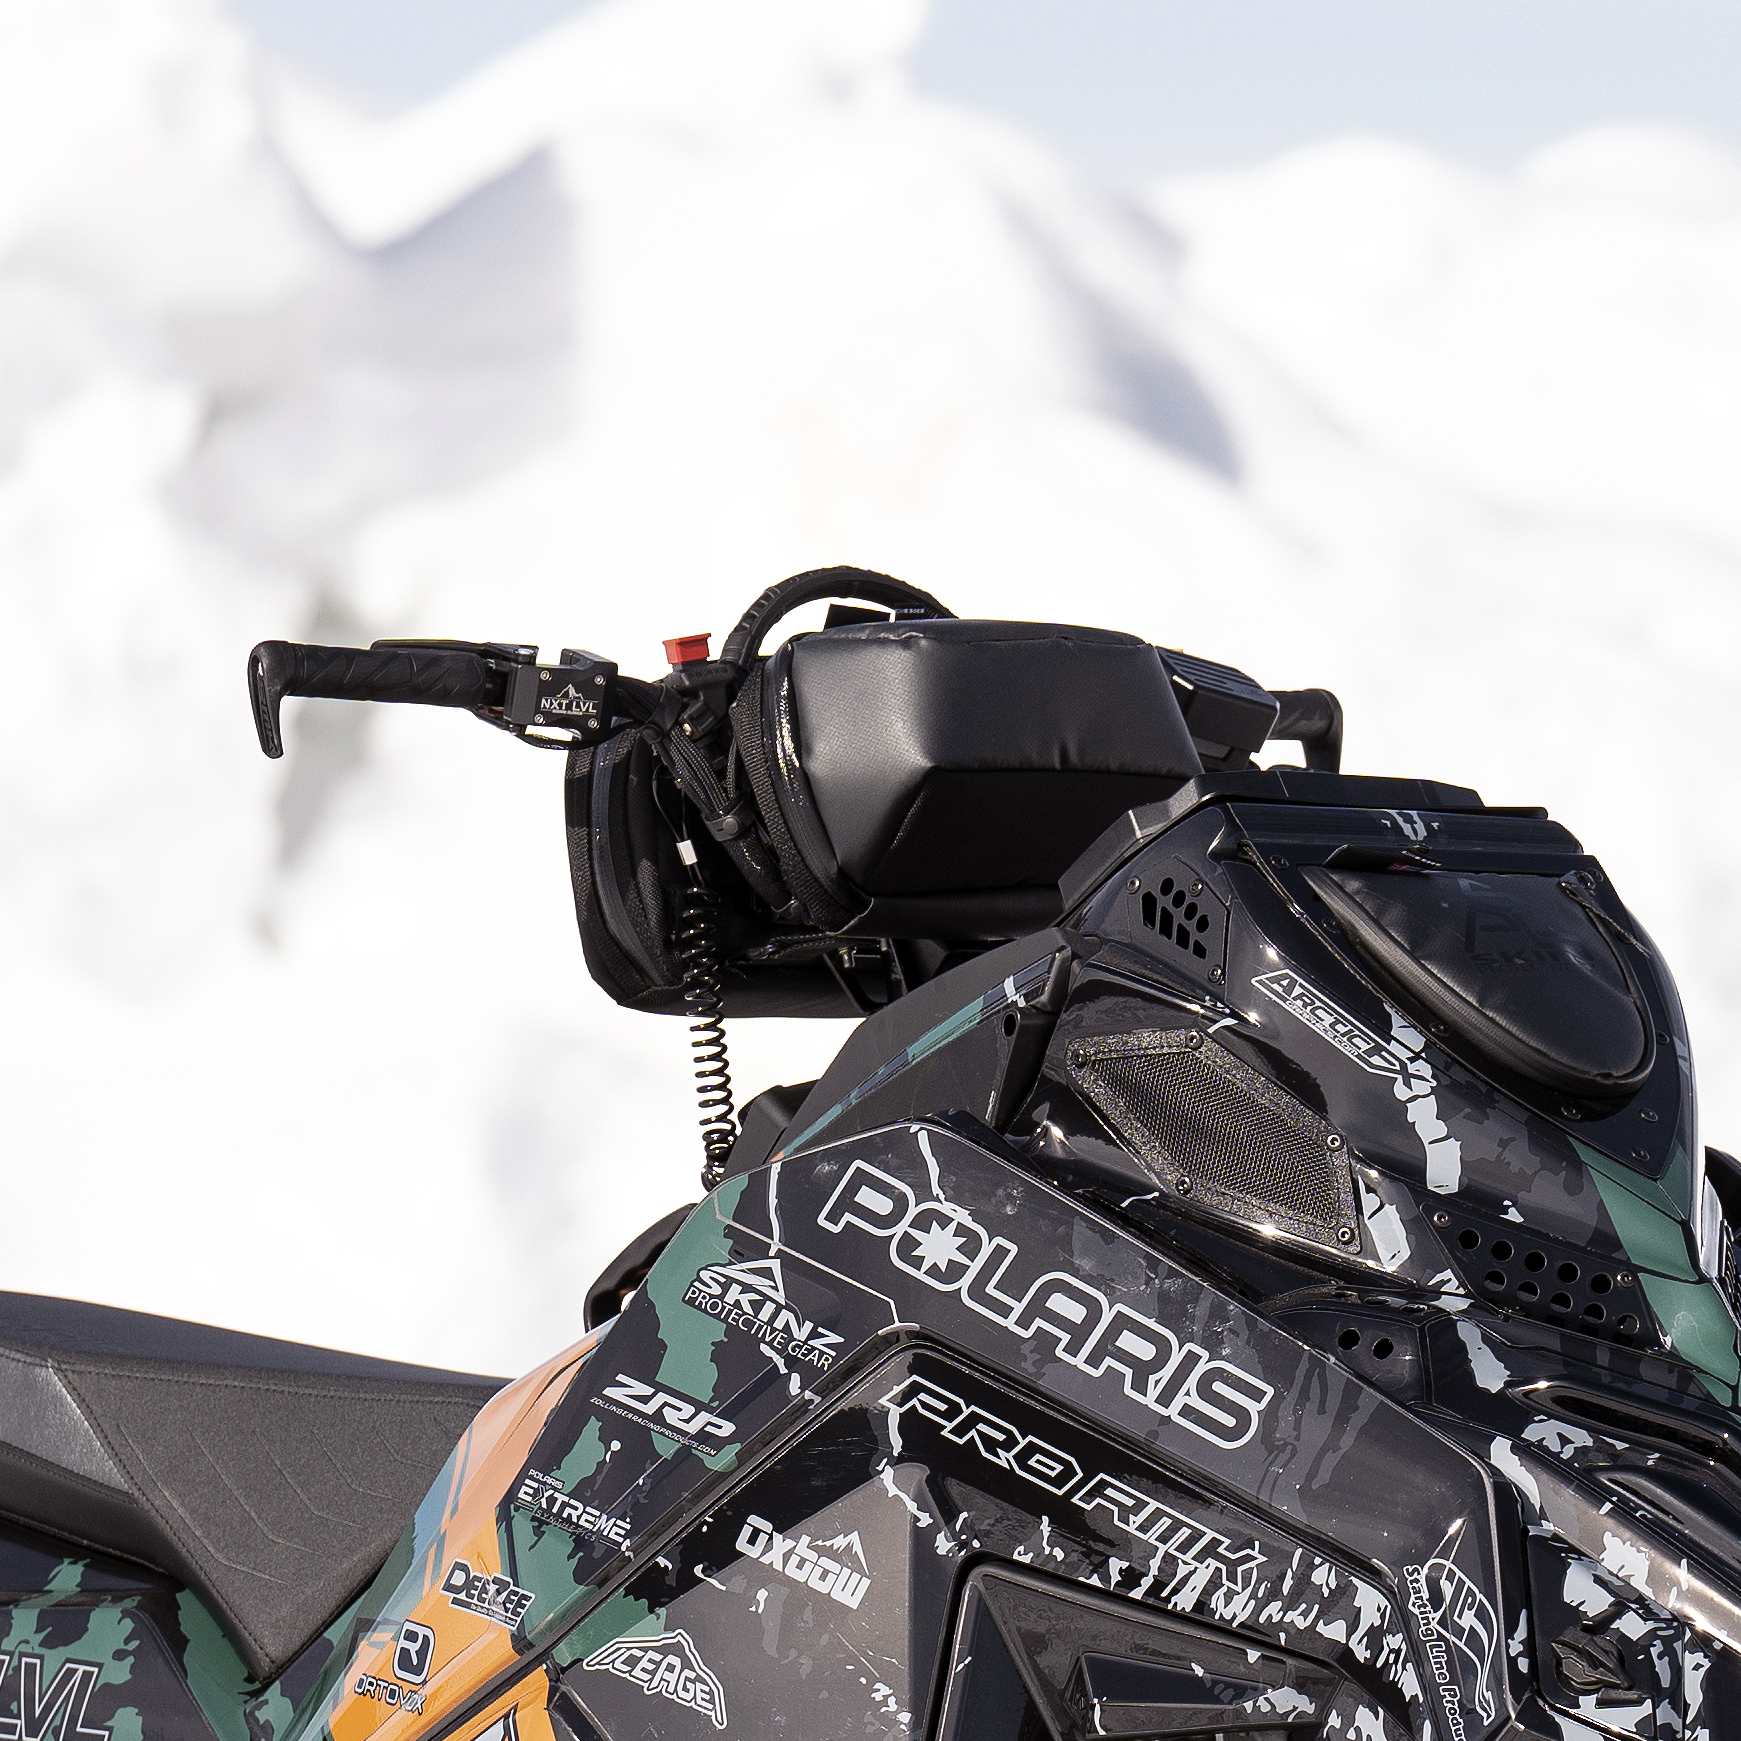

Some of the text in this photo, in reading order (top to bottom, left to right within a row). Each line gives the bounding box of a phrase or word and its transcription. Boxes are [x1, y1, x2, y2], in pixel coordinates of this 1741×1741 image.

[540, 698, 569, 711] NXT
[572, 701, 598, 713] LVL
[685, 1286, 834, 1371] PROTECTIVE GEAR
[693, 1268, 845, 1357] SKINZ
[818, 1159, 1275, 1449] POLARIS
[602, 1373, 736, 1438] ZRP
[517, 1479, 631, 1540] EXTREME
[528, 1468, 563, 1489] POLARIS
[879, 1374, 1268, 1592] PRO RMK
[1403, 1564, 1437, 1641] Starting
[1426, 1641, 1451, 1683] Line
[354, 1673, 427, 1715] ORTOVOX
